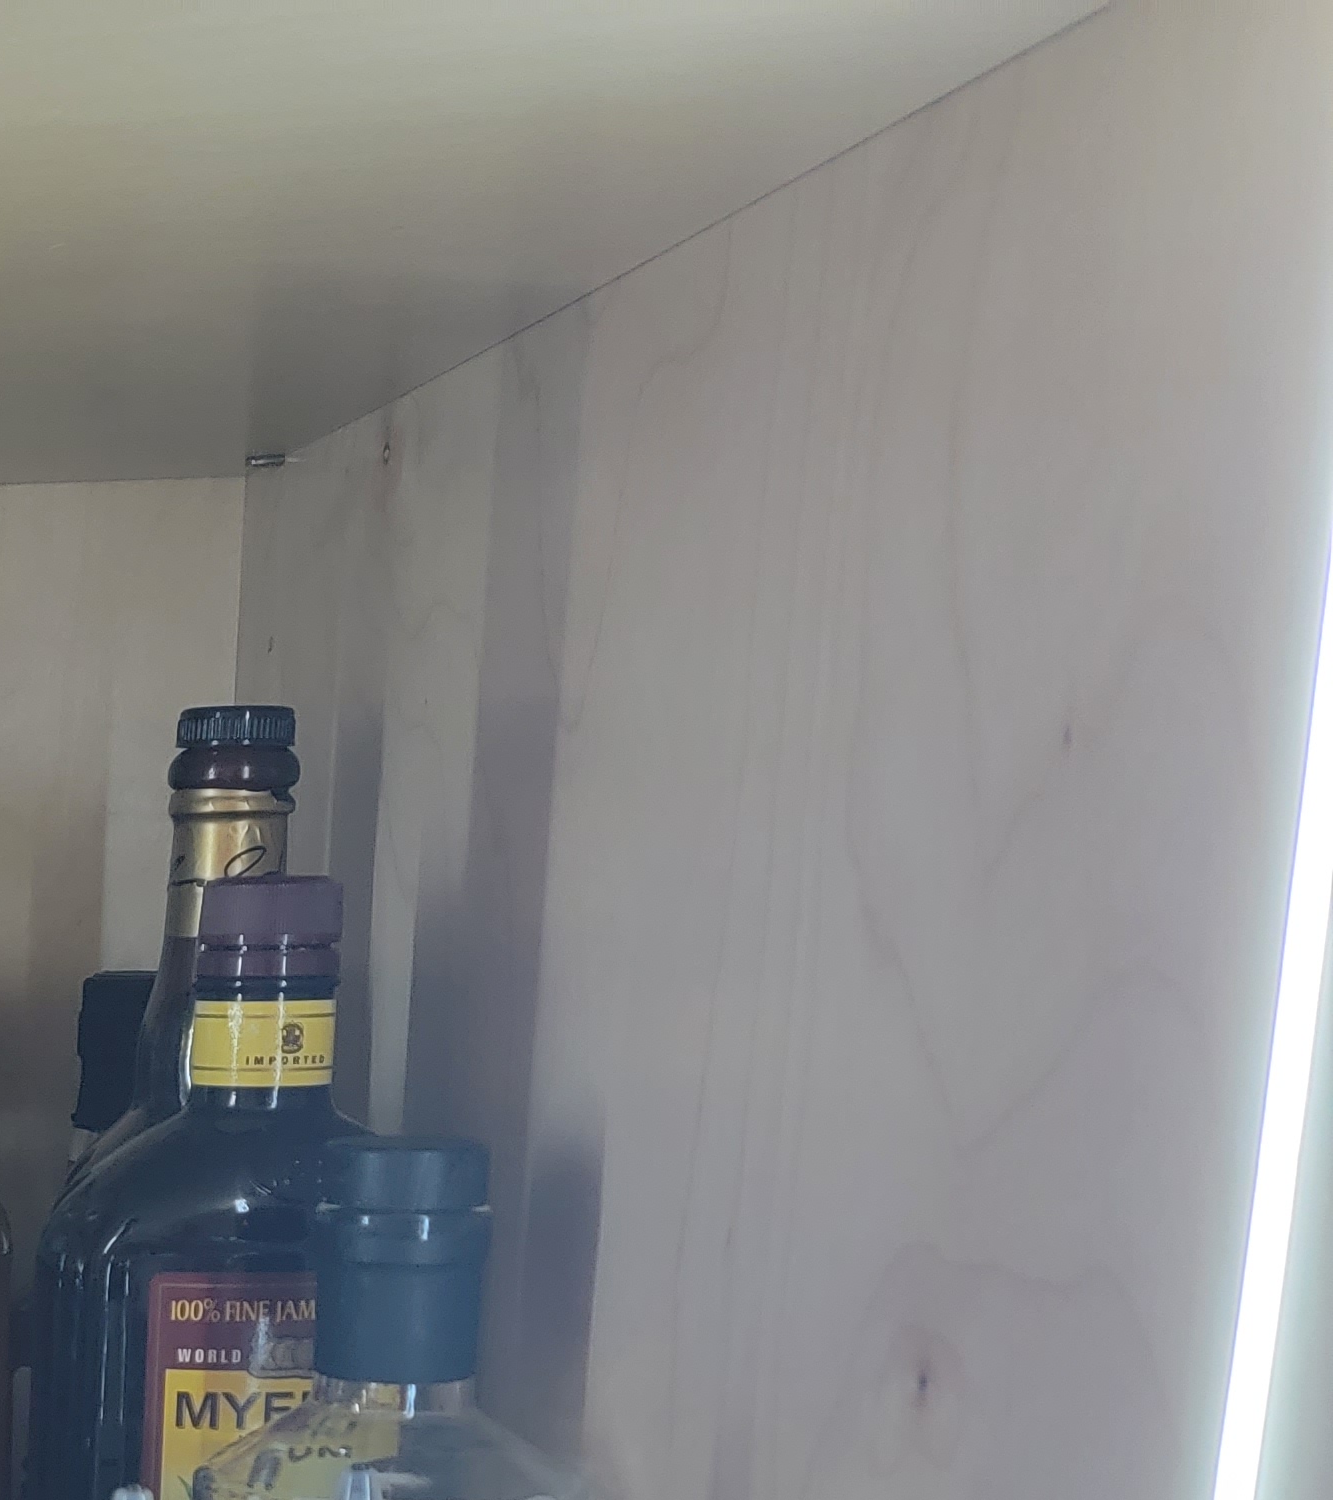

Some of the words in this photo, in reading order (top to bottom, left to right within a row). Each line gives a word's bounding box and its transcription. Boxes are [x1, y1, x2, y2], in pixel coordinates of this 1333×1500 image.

[246, 1054, 325, 1066] IMPORTED
[170, 1298, 220, 1323] 100%
[225, 1299, 270, 1322] FINE
[177, 1348, 242, 1364] WORLD
